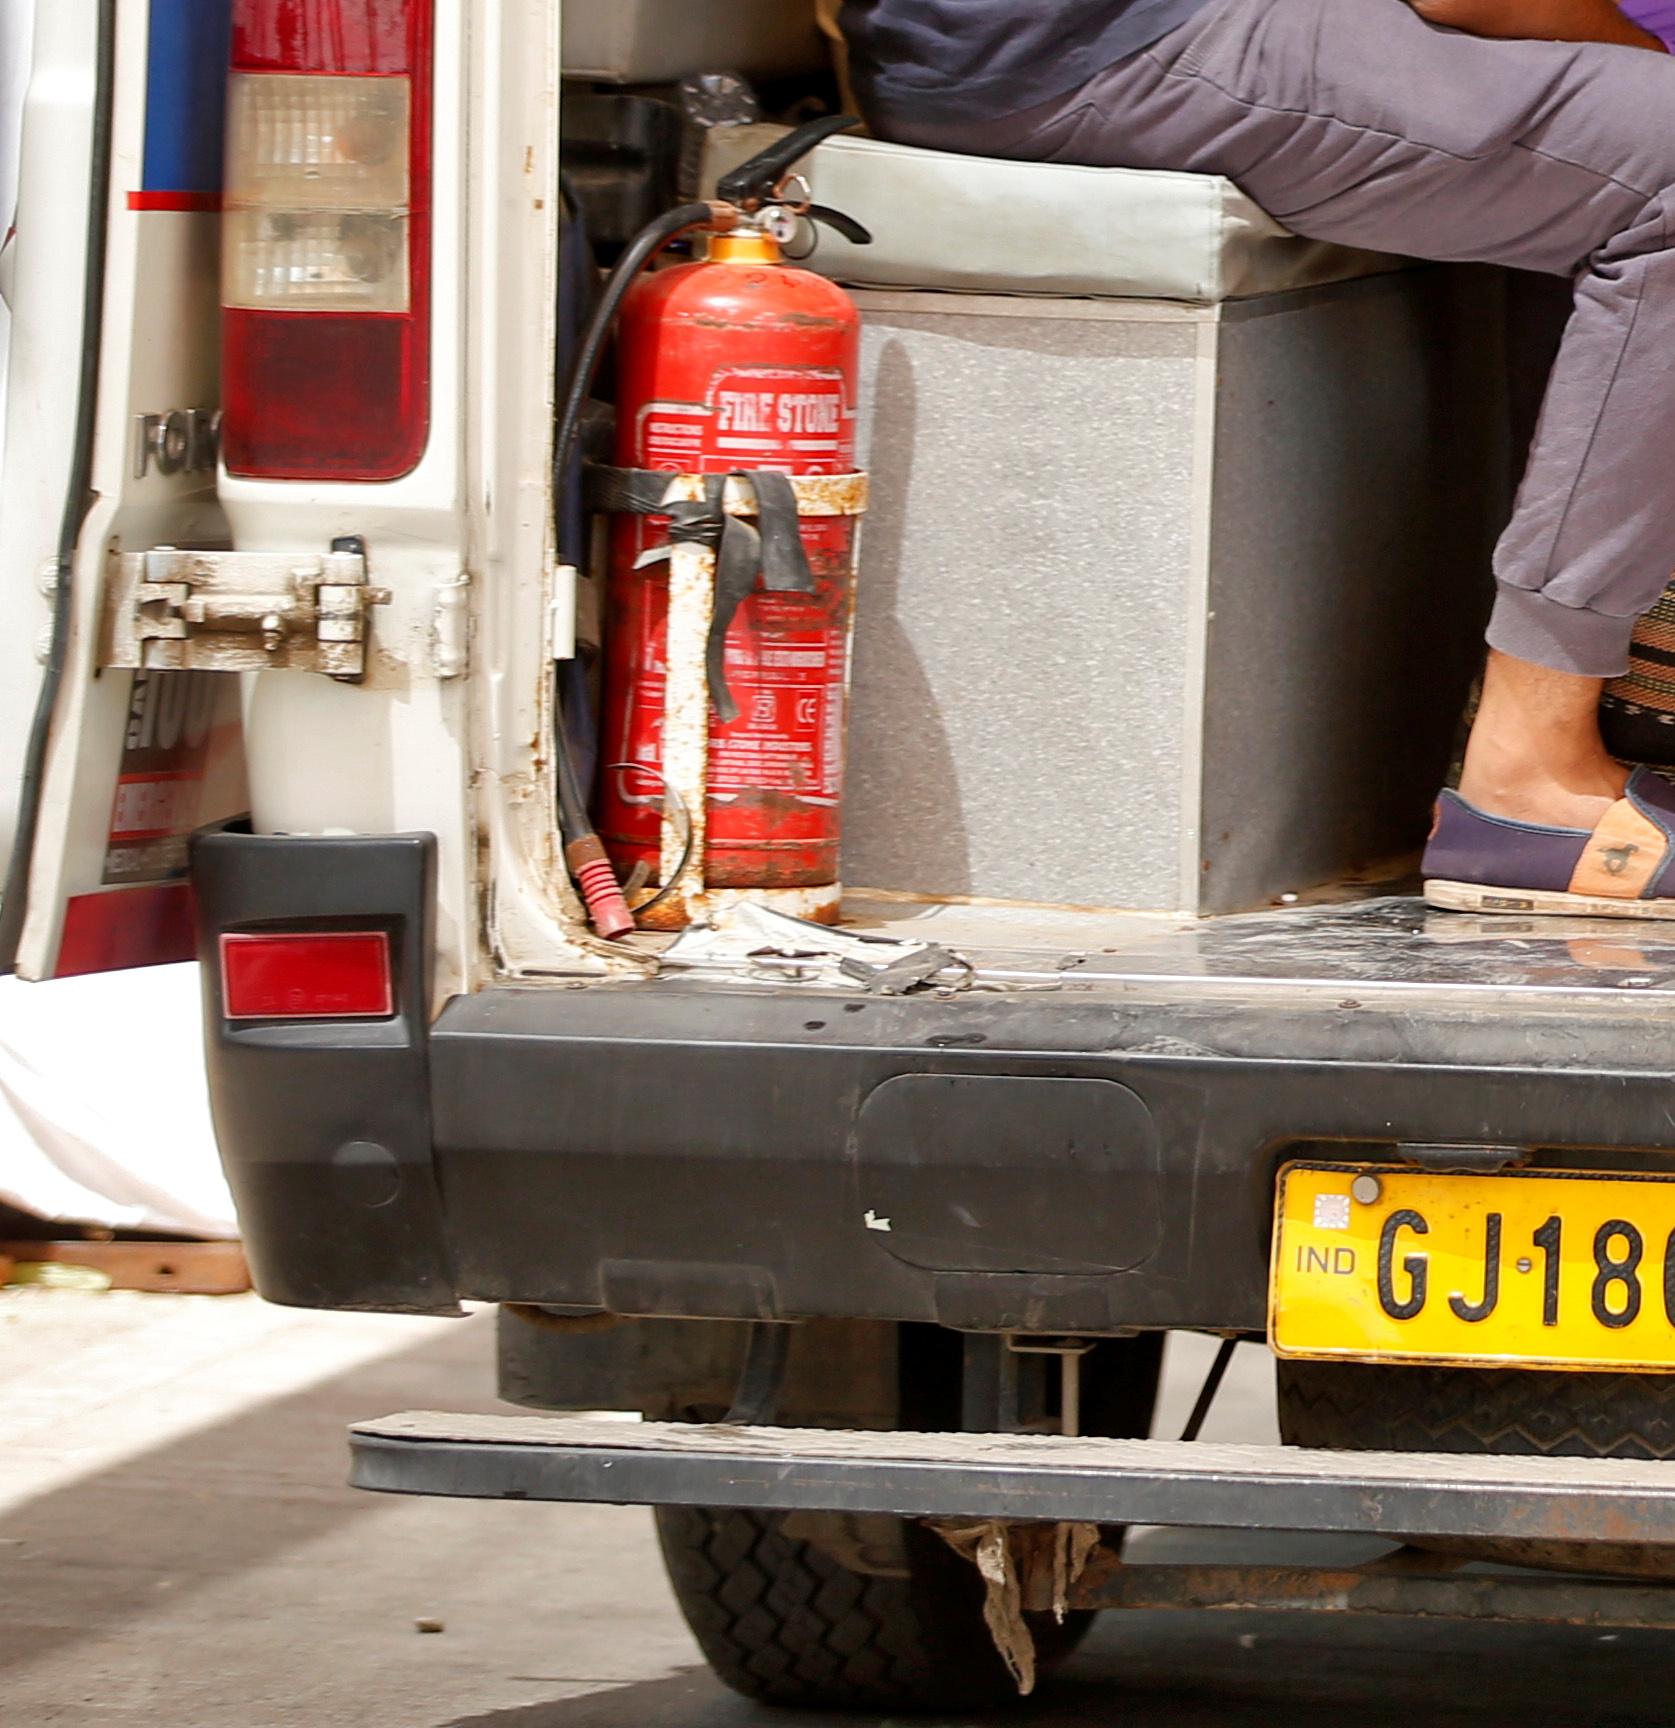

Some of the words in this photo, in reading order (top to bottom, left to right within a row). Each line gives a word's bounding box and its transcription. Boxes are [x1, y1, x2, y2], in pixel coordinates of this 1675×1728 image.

[717, 390, 775, 432] FIRE
[776, 392, 841, 434] STONE
[1296, 1245, 1356, 1275] IND
